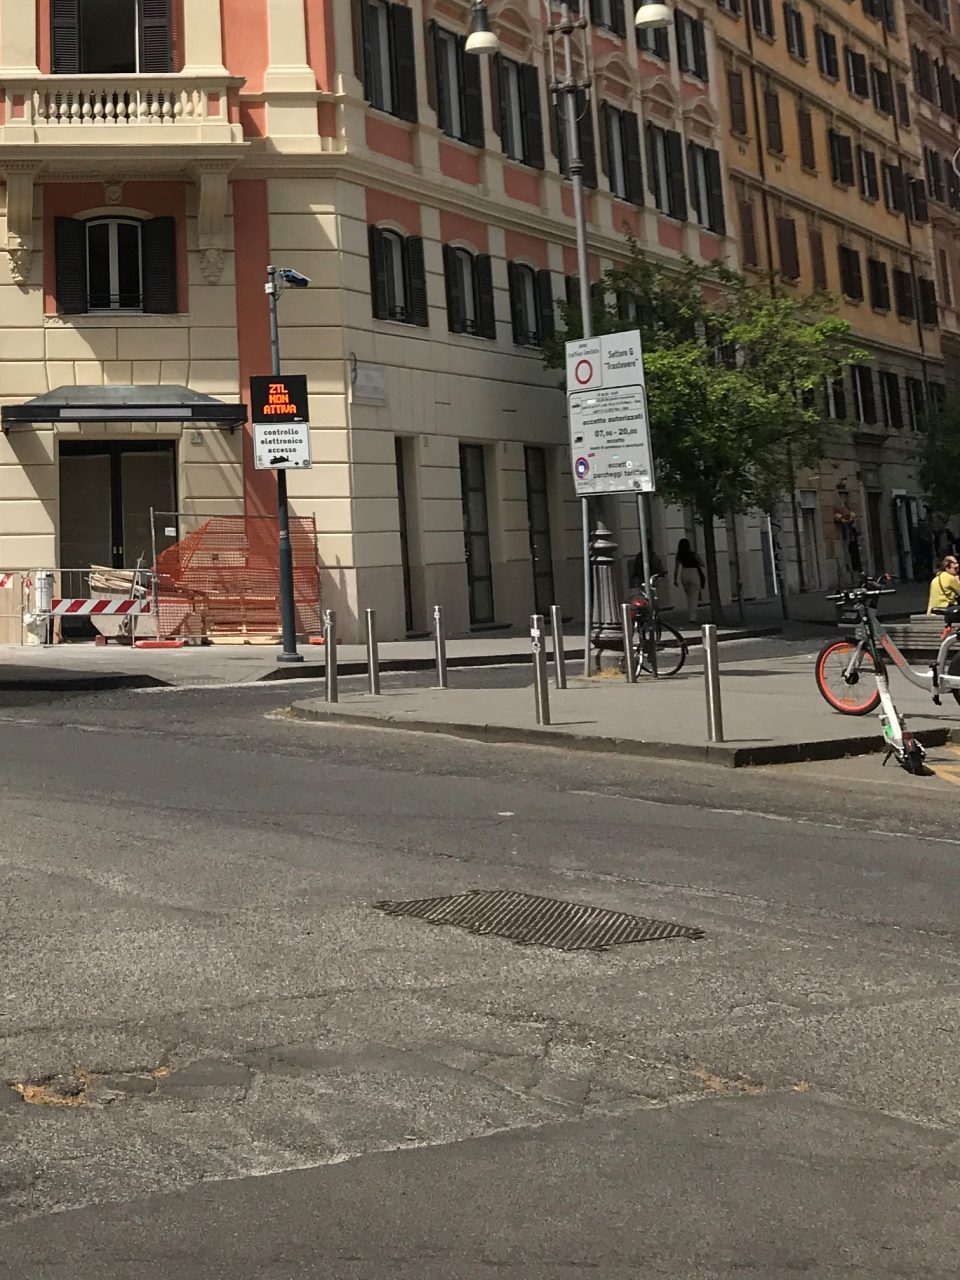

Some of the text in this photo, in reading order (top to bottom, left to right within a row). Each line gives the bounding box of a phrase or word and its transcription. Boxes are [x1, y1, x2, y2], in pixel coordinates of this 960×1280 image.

[269, 384, 288, 393] ZTL
[269, 394, 289, 404] NON
[263, 404, 297, 415] ATTIVA
[264, 428, 299, 436] controllo
[261, 437, 303, 445] elettronico
